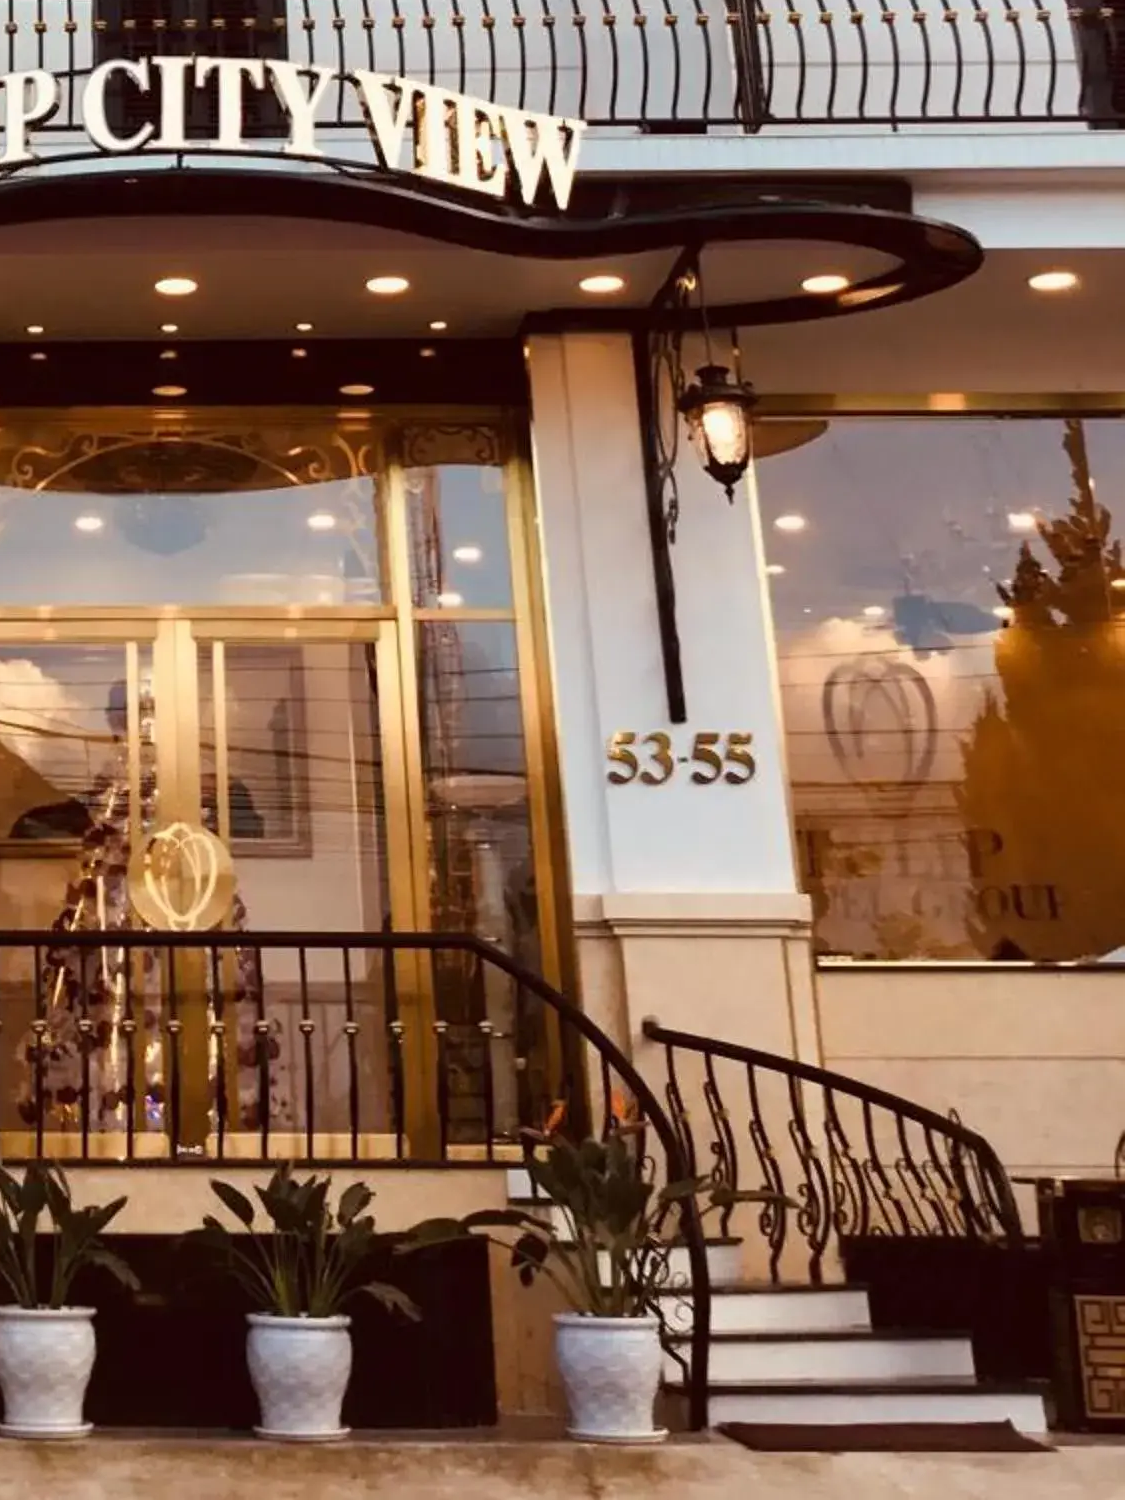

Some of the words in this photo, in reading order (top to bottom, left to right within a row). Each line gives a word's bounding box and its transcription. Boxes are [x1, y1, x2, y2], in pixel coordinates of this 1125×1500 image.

[82, 55, 336, 155] CITY
[353, 68, 587, 211] VIEW
[606, 731, 756, 785] 53-55
